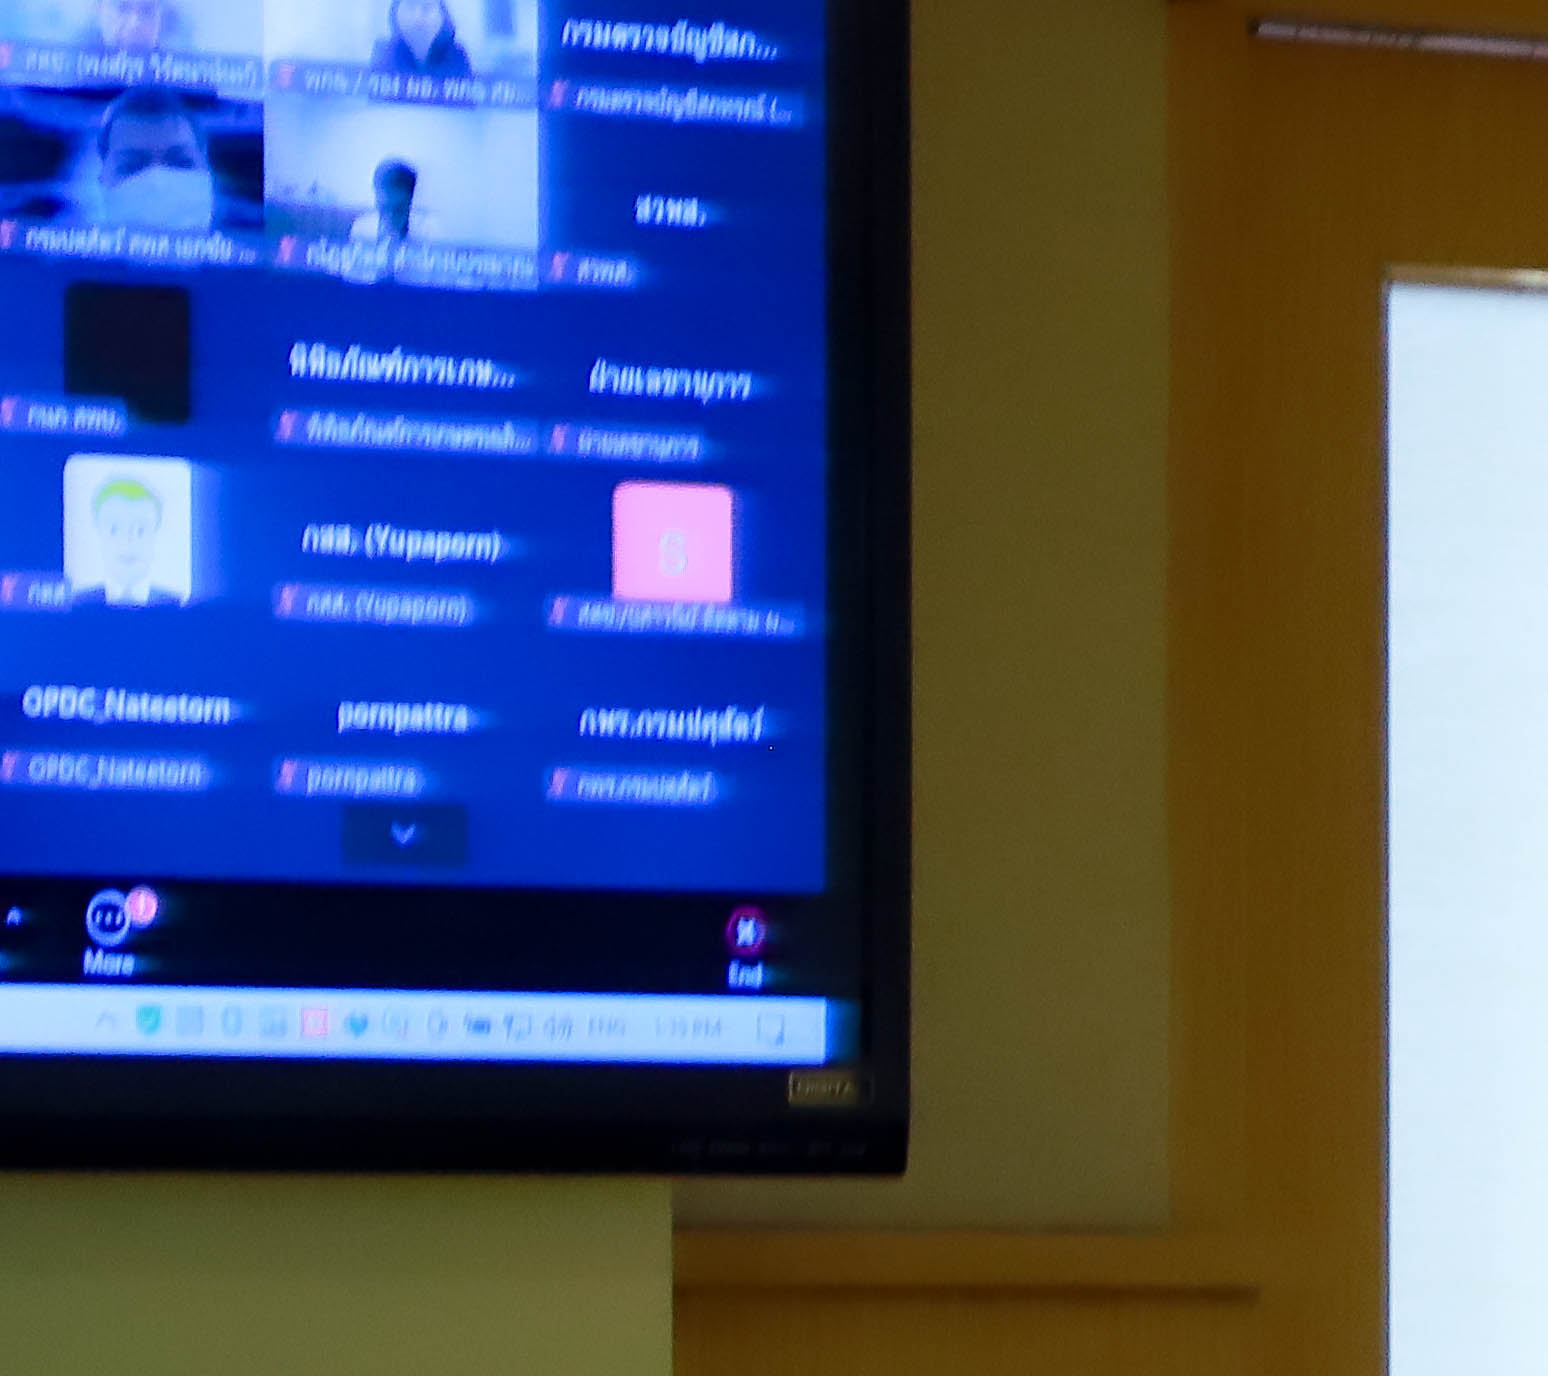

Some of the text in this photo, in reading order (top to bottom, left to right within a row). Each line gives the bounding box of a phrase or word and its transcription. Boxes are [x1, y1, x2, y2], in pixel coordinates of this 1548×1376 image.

[364, 522, 502, 566] (Yupaporn)
[337, 700, 470, 737] pornpattra
[84, 946, 135, 978] More
[728, 958, 763, 989] End
